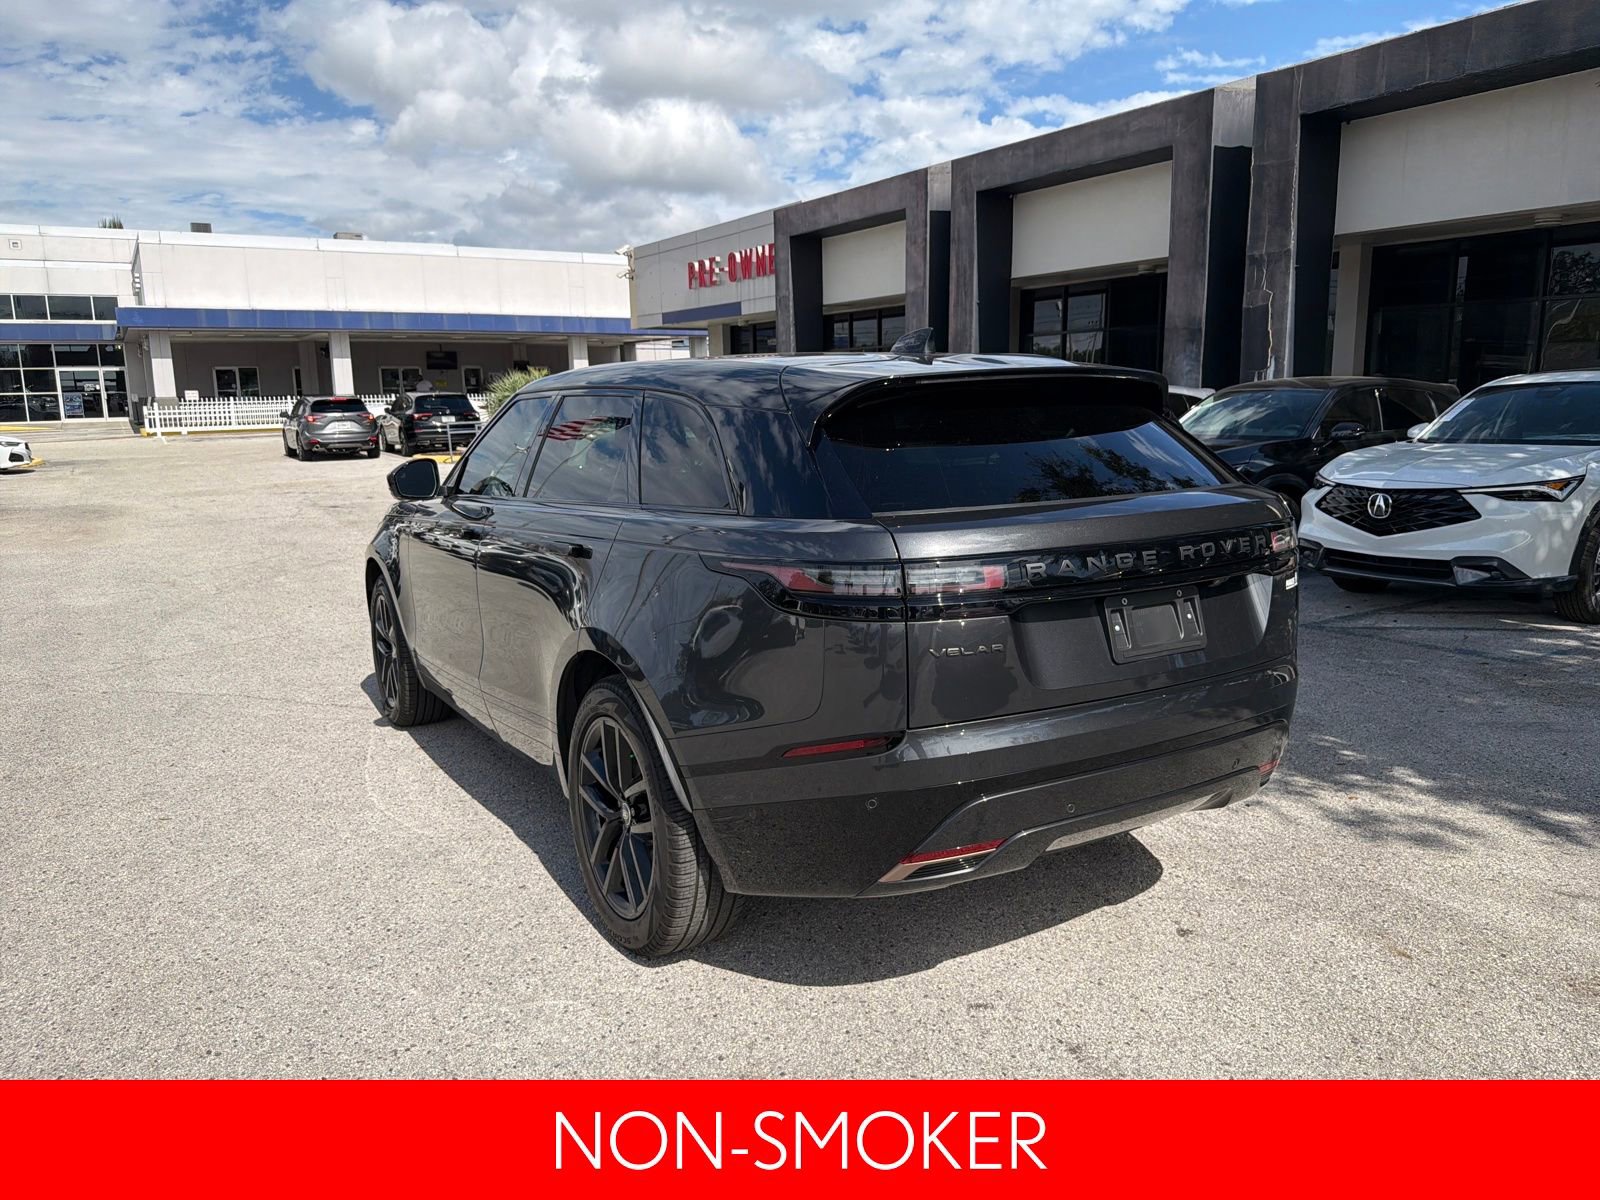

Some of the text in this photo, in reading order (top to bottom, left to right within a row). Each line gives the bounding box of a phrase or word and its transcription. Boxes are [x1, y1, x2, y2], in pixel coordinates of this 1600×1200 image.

[1025, 534, 1267, 579] RANGE ROVER
[929, 643, 1004, 657] VELAR
